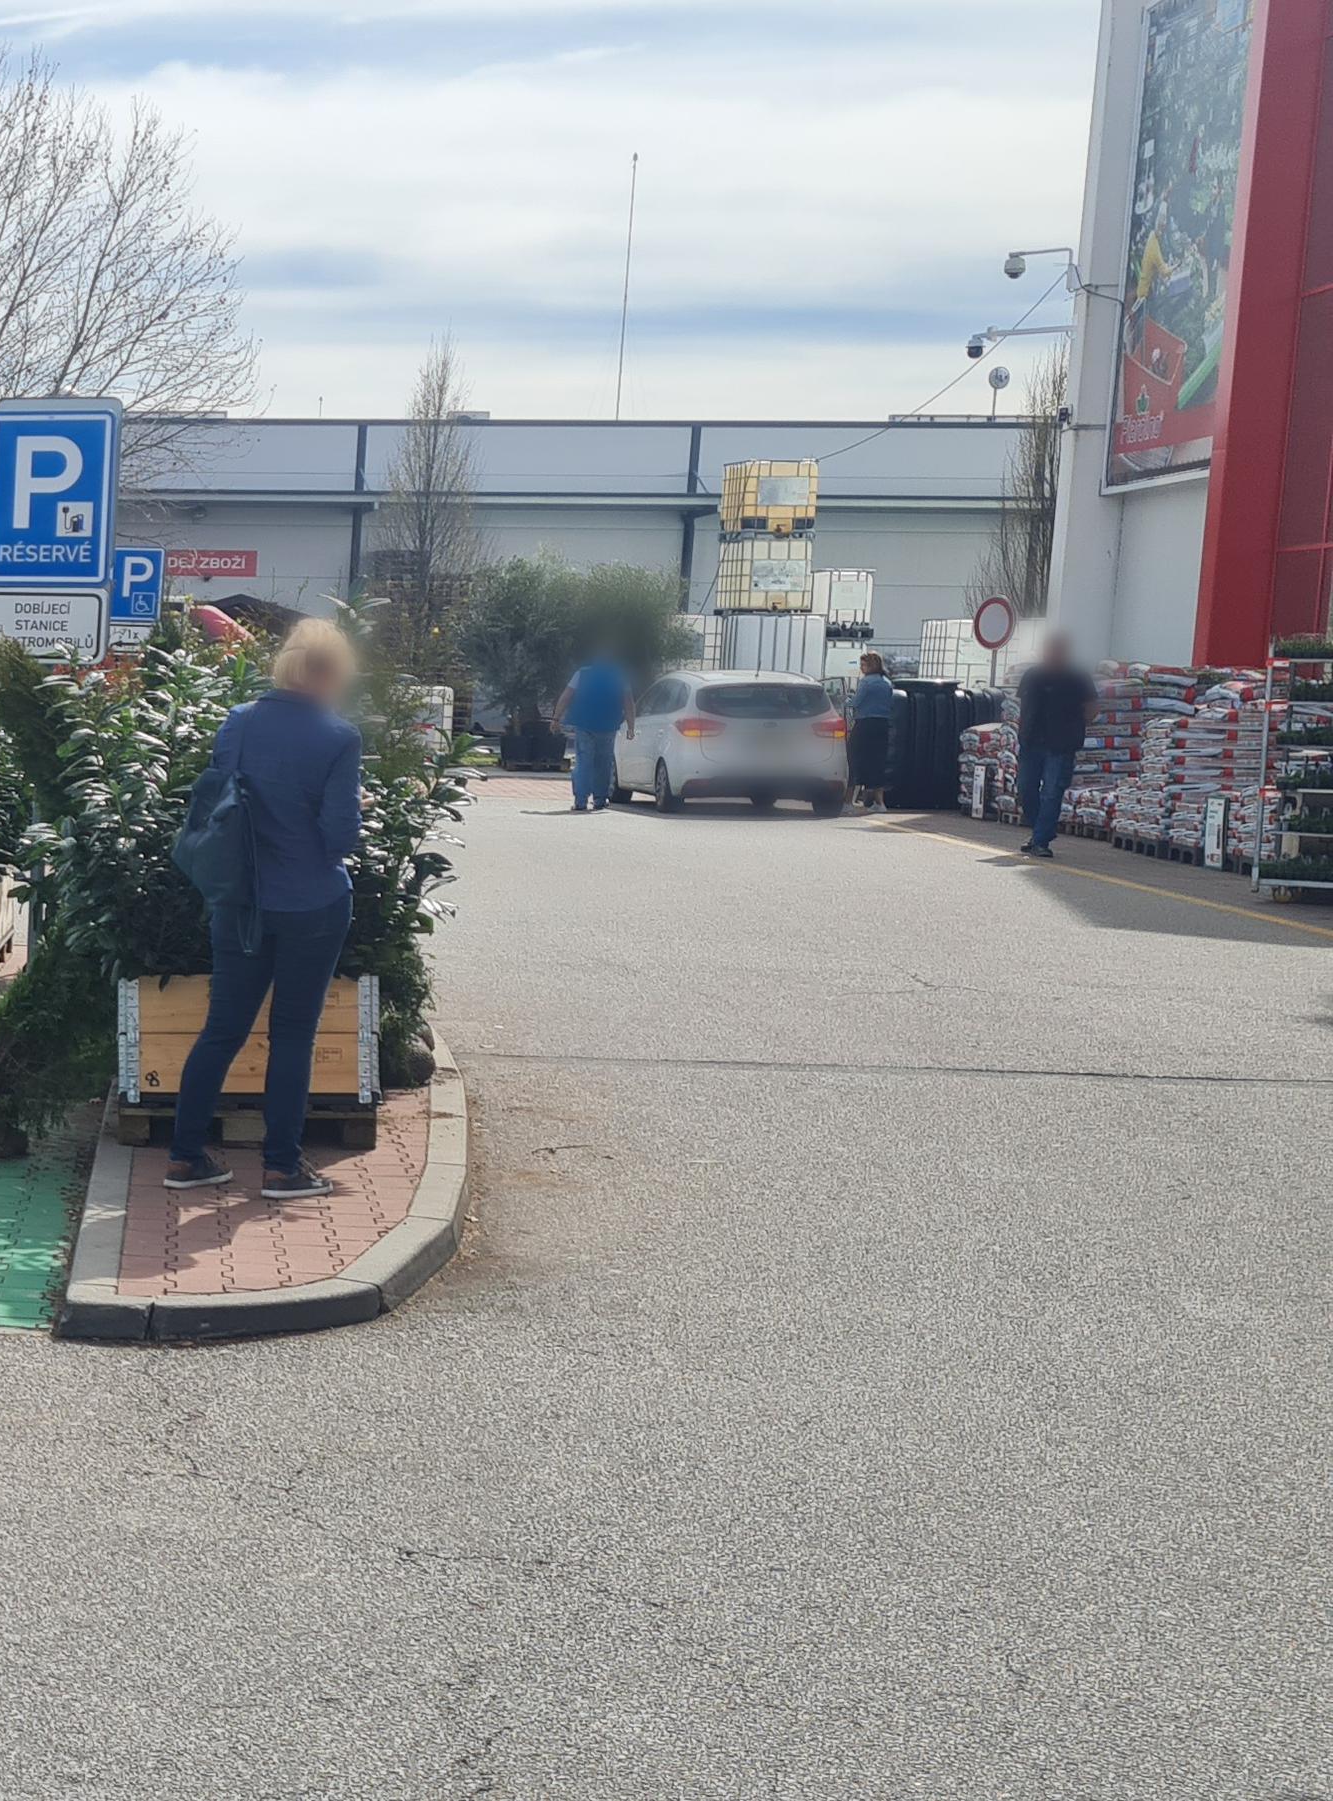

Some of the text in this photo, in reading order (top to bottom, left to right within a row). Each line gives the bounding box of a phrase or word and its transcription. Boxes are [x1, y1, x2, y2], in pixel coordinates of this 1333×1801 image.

[13, 435, 84, 529] P
[167, 554, 246, 570] DEJ ZBOŽÍ
[121, 556, 154, 598] P
[14, 600, 72, 615] DOBÍJECÍ
[15, 619, 69, 632] STANICE
